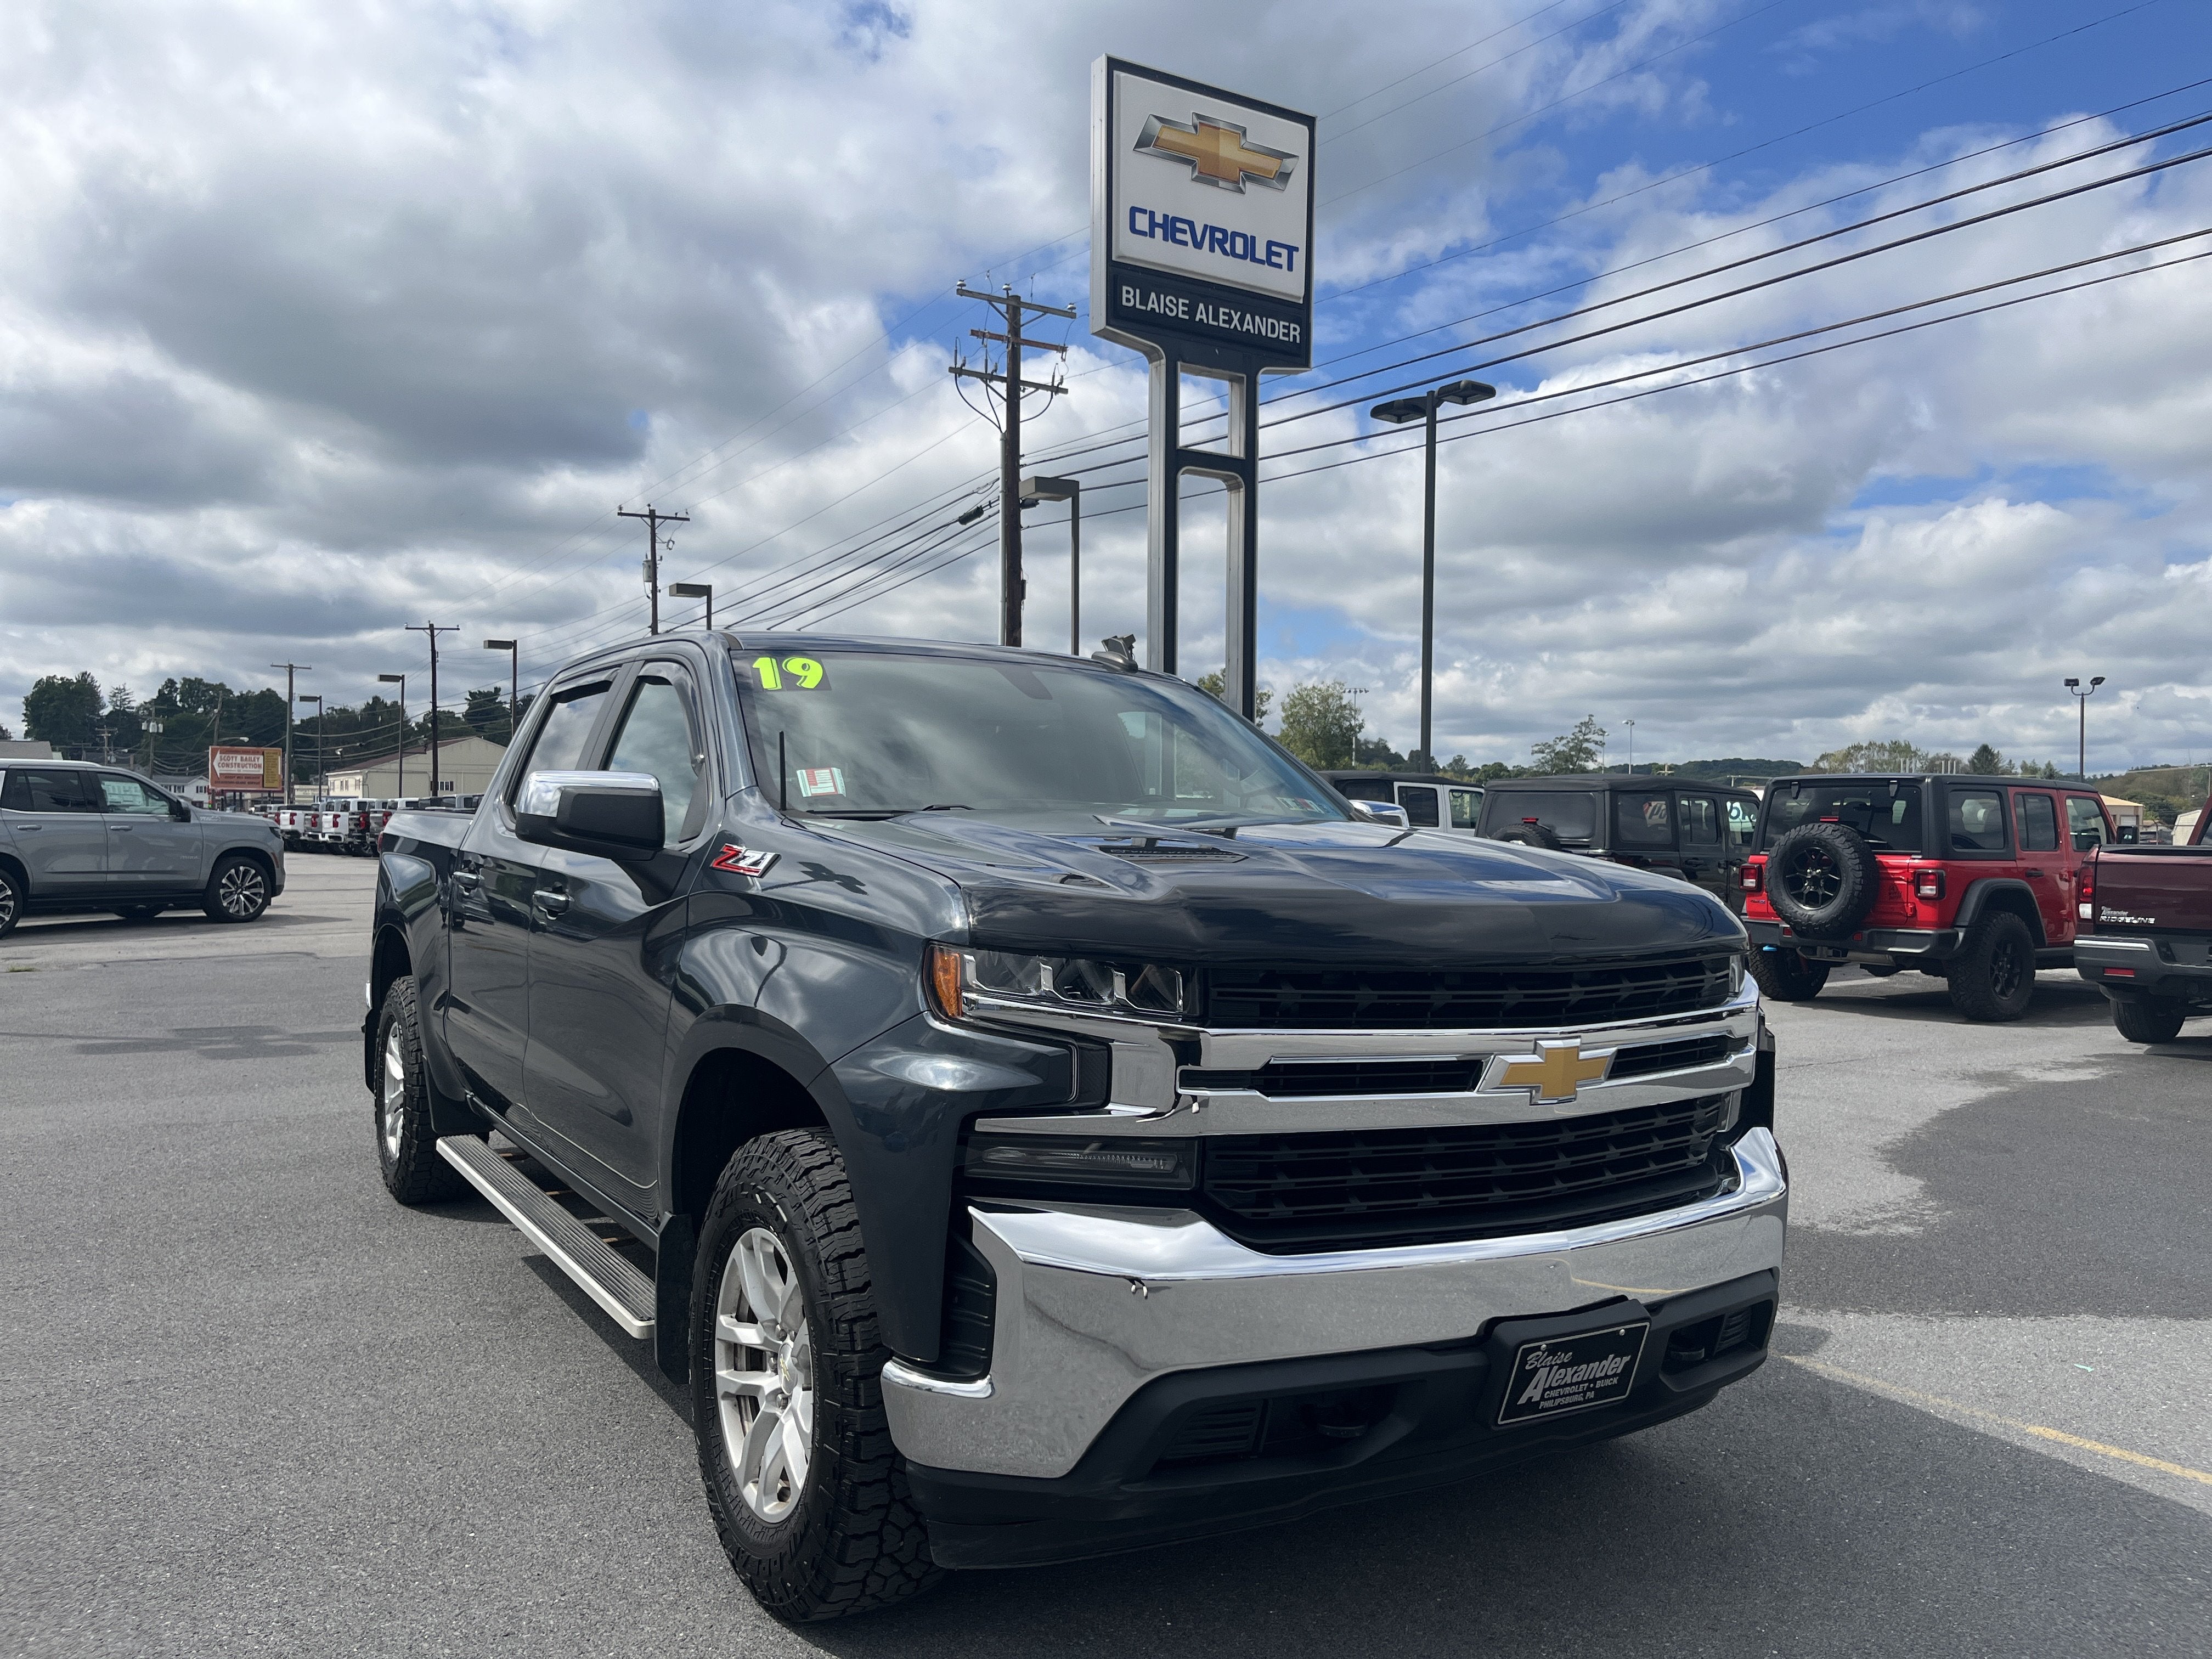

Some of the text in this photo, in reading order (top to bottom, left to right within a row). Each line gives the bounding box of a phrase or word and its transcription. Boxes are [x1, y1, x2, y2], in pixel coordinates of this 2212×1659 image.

[1129, 206, 1299, 272] CHEVROLET
[1122, 285, 1301, 344] BLAISE ALEXANDER
[752, 657, 823, 690] 19
[710, 843, 781, 878] Z71
[1525, 1351, 1573, 1370] Blaise
[1517, 1353, 1632, 1405] Alexander
[1544, 1376, 1619, 1398] CHEVROLET BUICK
[1539, 1391, 1595, 1409] PHILIPSBURG, PA
